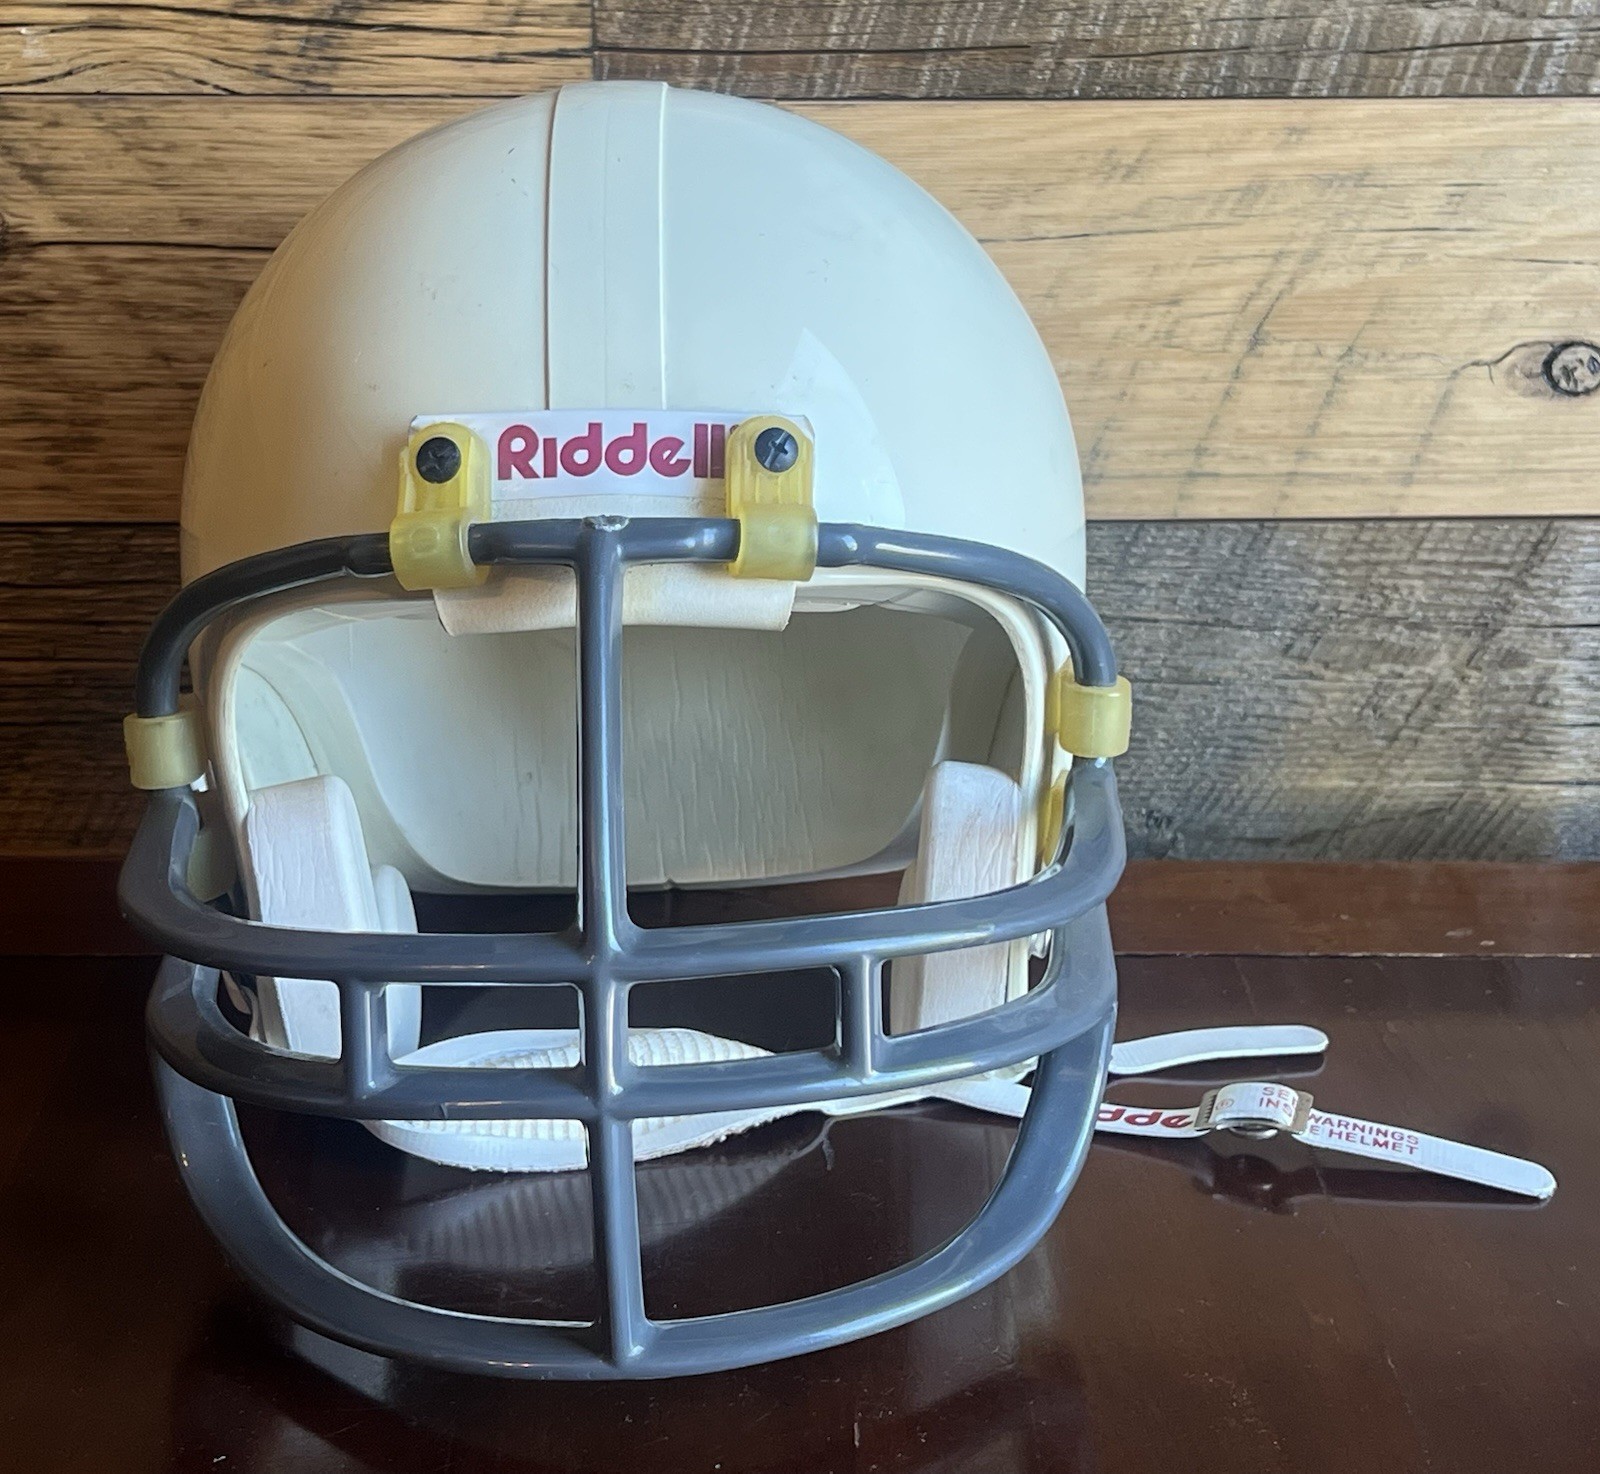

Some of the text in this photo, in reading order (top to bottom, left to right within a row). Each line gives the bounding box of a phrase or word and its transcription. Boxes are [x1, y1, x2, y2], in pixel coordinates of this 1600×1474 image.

[498, 422, 725, 480] Riddell
[1308, 1113, 1419, 1146] WARNINGS
[1328, 1128, 1419, 1155] HELMET
